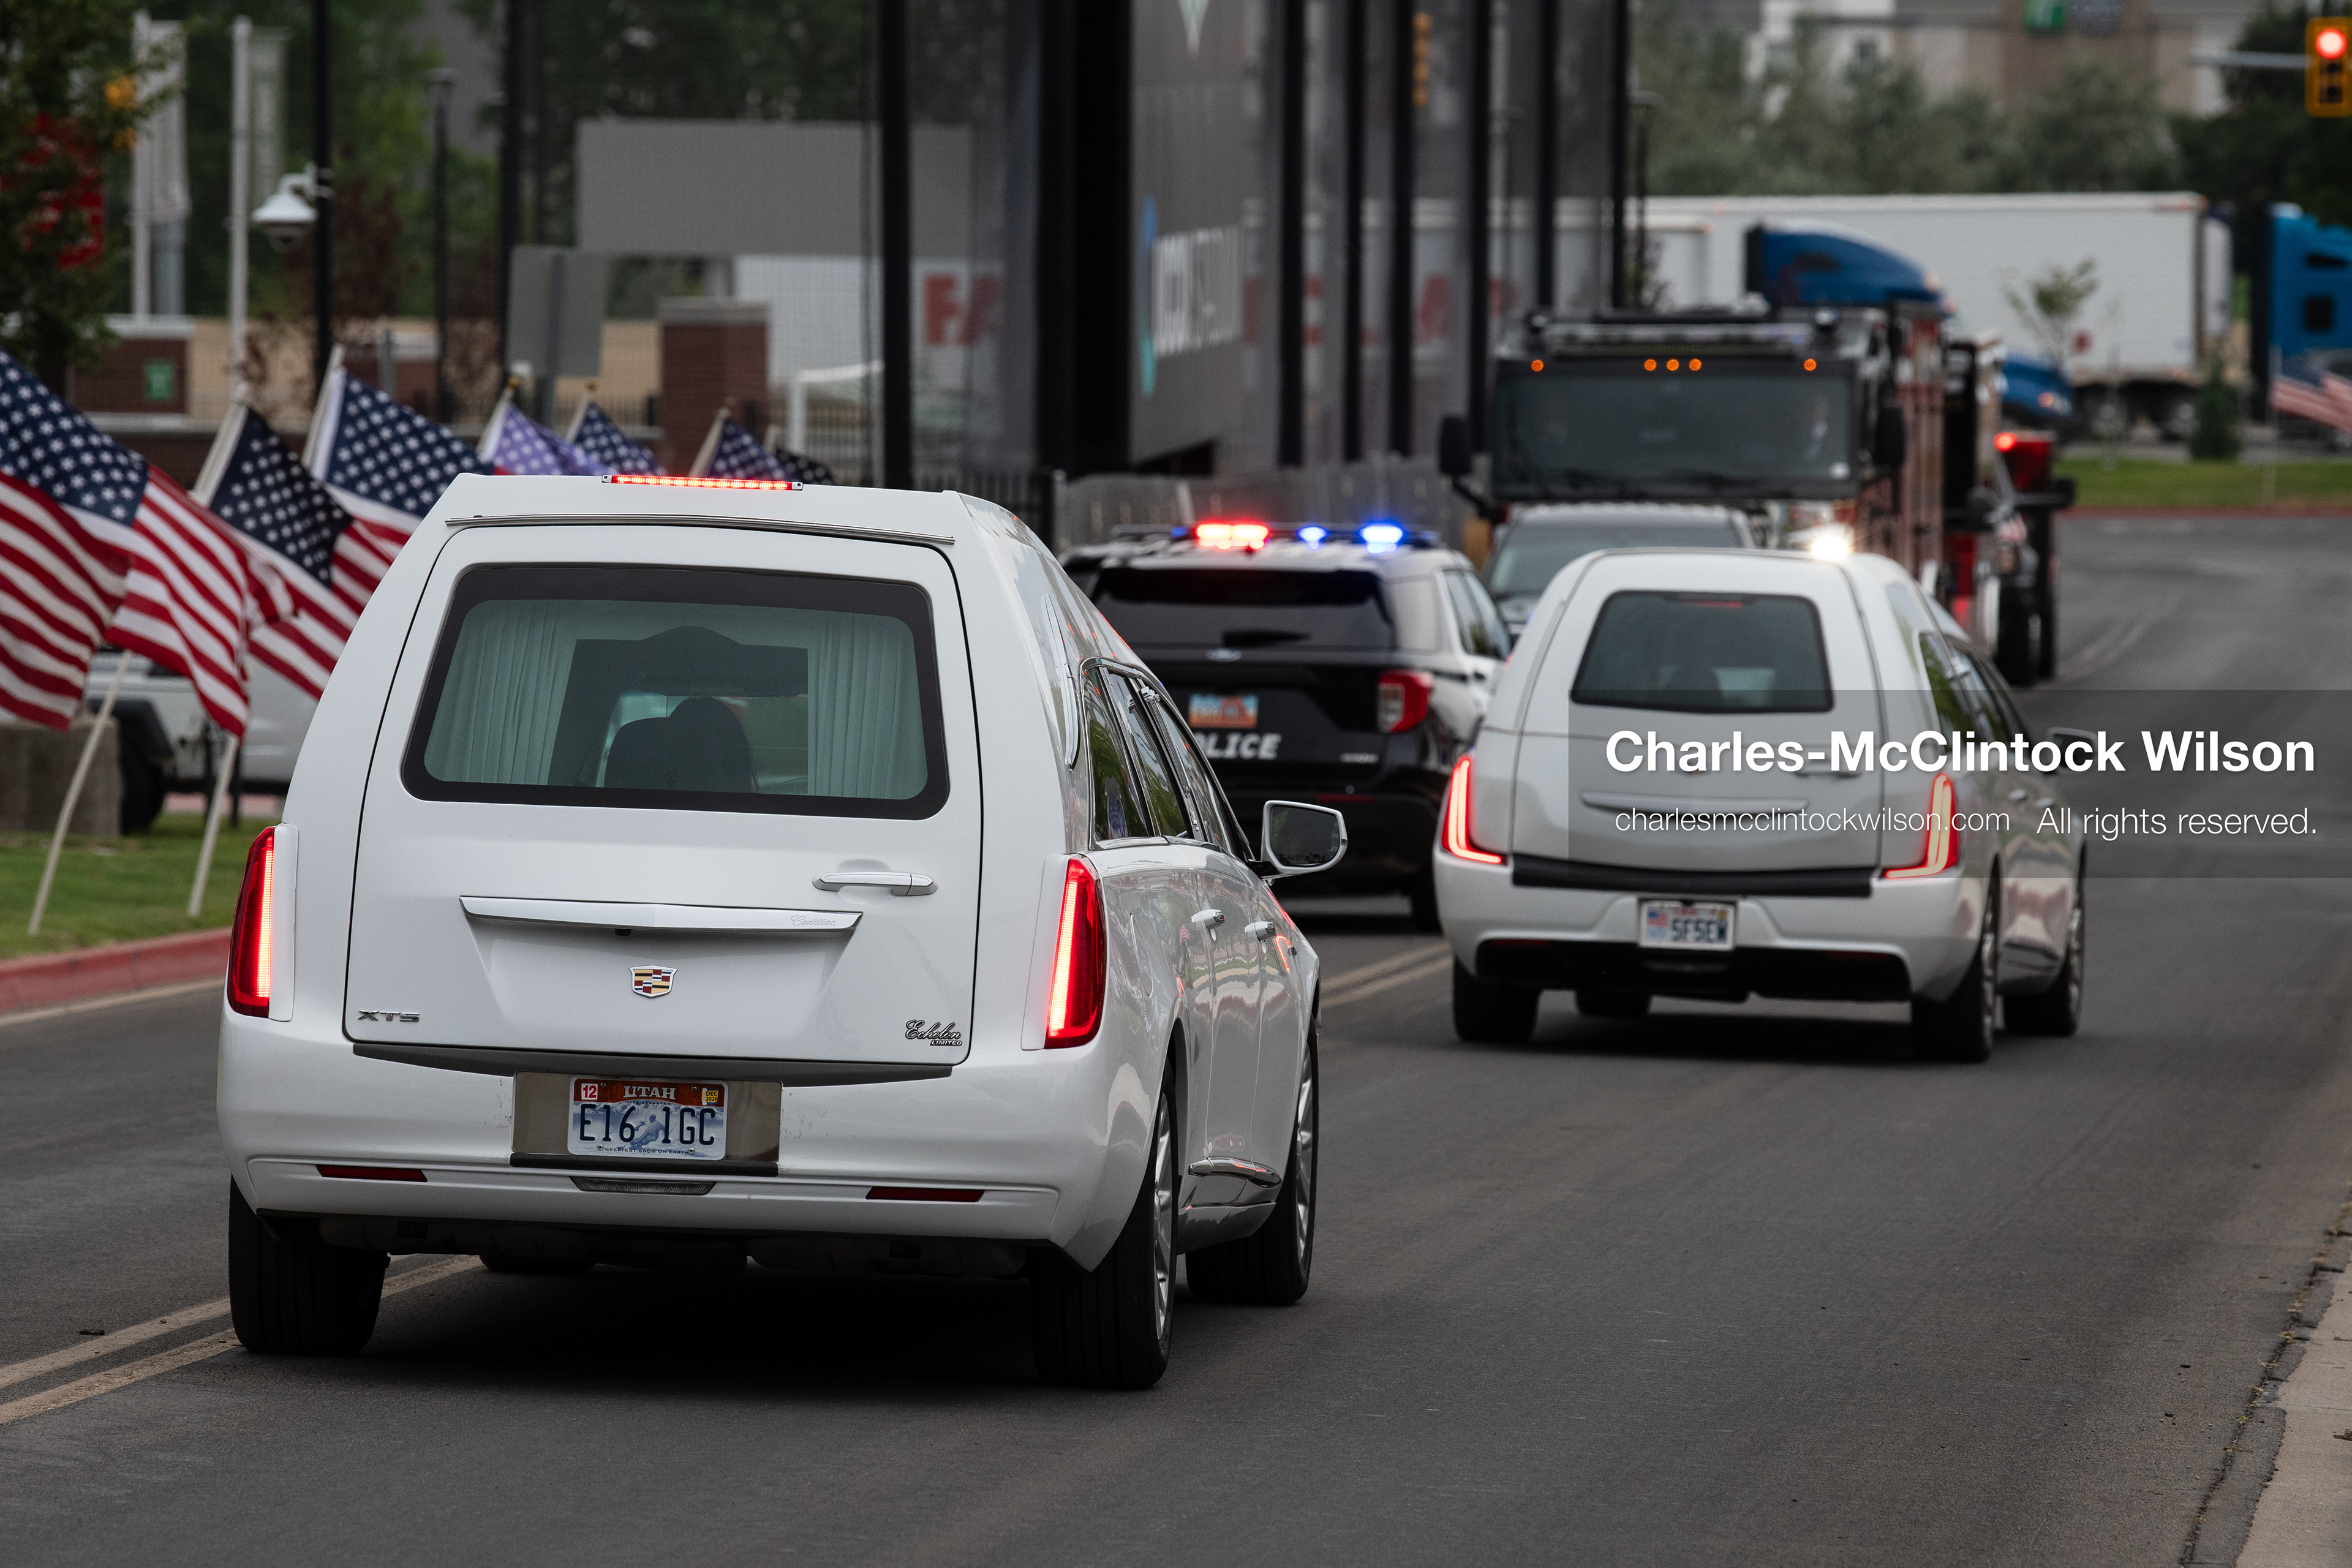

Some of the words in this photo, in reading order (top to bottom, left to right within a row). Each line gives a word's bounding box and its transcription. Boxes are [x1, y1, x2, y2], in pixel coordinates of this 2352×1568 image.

[1193, 733, 1283, 760] LICE
[790, 914, 836, 927] Cadillac
[357, 1009, 420, 1022] XTS
[905, 1019, 962, 1039] Echelon
[582, 1085, 597, 1098] 12
[623, 1085, 676, 1100] UTAH
[579, 1104, 636, 1142] E16
[662, 1106, 716, 1145] 1GC
